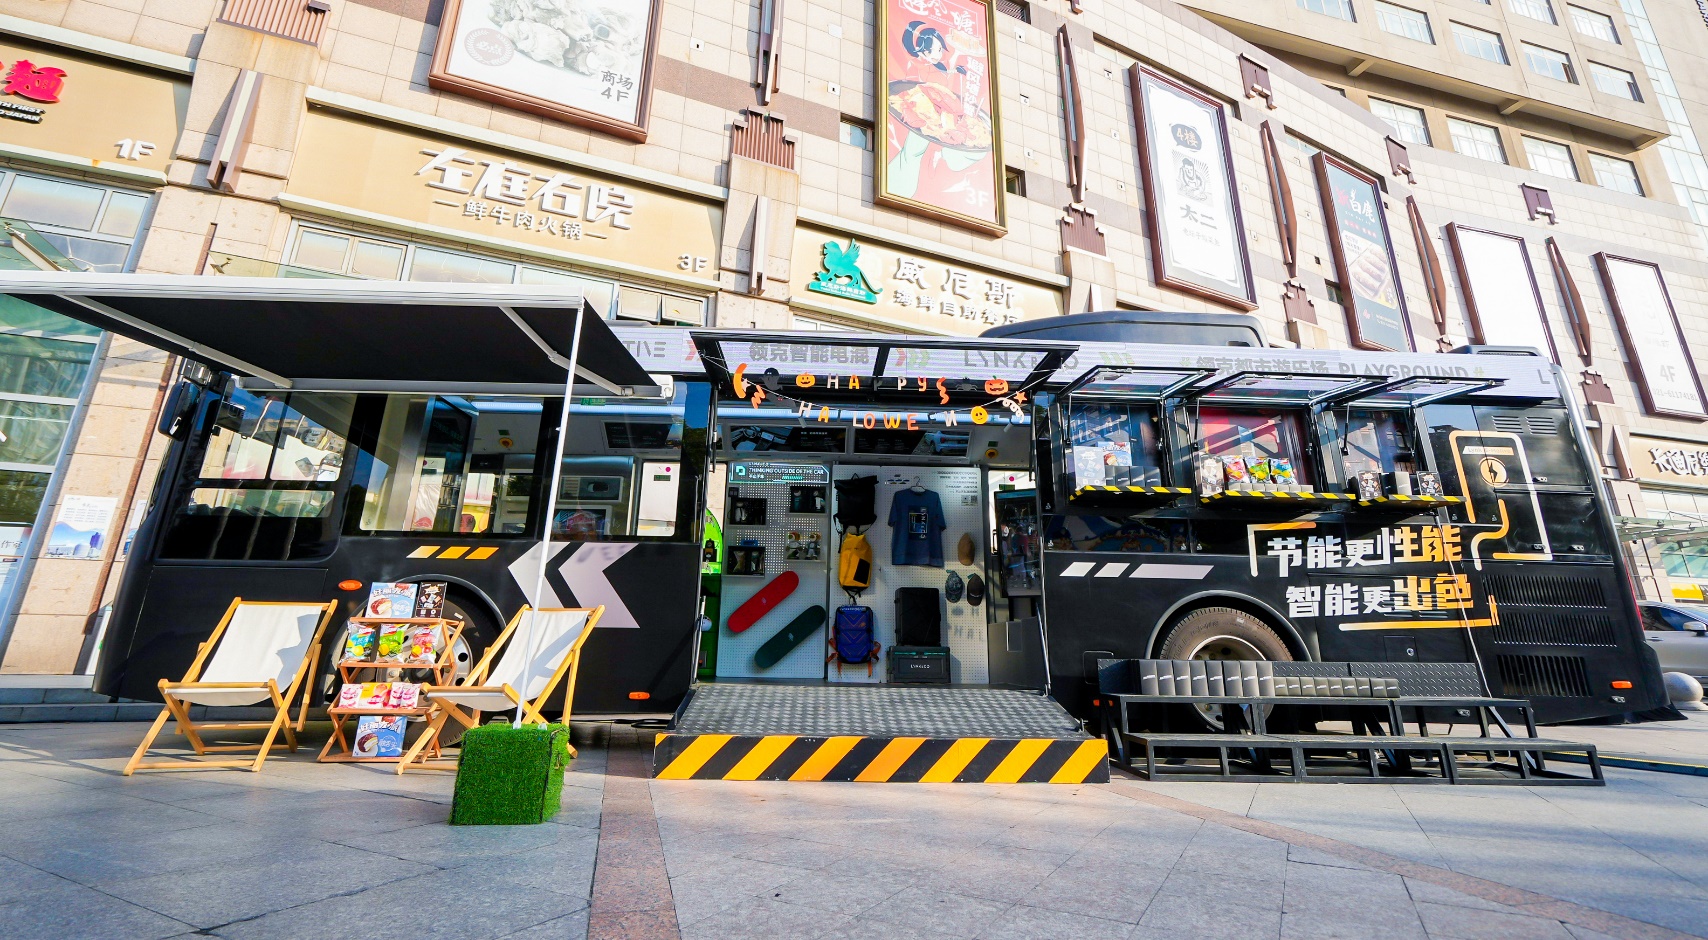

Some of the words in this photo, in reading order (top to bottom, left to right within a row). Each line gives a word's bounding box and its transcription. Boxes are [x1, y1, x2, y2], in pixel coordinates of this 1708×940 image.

[601, 70, 634, 90] 商场
[601, 87, 630, 101] 4F
[5, 111, 41, 123] JAPAN
[1174, 127, 1199, 148] 4楼
[114, 138, 157, 161] 1F
[414, 146, 635, 230] 左庭右院
[965, 186, 989, 208] 3F
[463, 199, 584, 240] 鲜牛肉火锅
[1179, 203, 1218, 231] 太二
[678, 253, 708, 273] 3F
[892, 256, 1019, 309] 威尼斯
[893, 288, 1020, 326] 海鲜自助餐厅
[749, 342, 870, 365] 领克智能电混
[1337, 361, 1469, 379] PLAYGROUND
[1659, 364, 1676, 383] 4F
[826, 373, 928, 393] HAPPY
[1267, 525, 1463, 578] 节能更性能
[1285, 573, 1474, 618] 智能更出色
